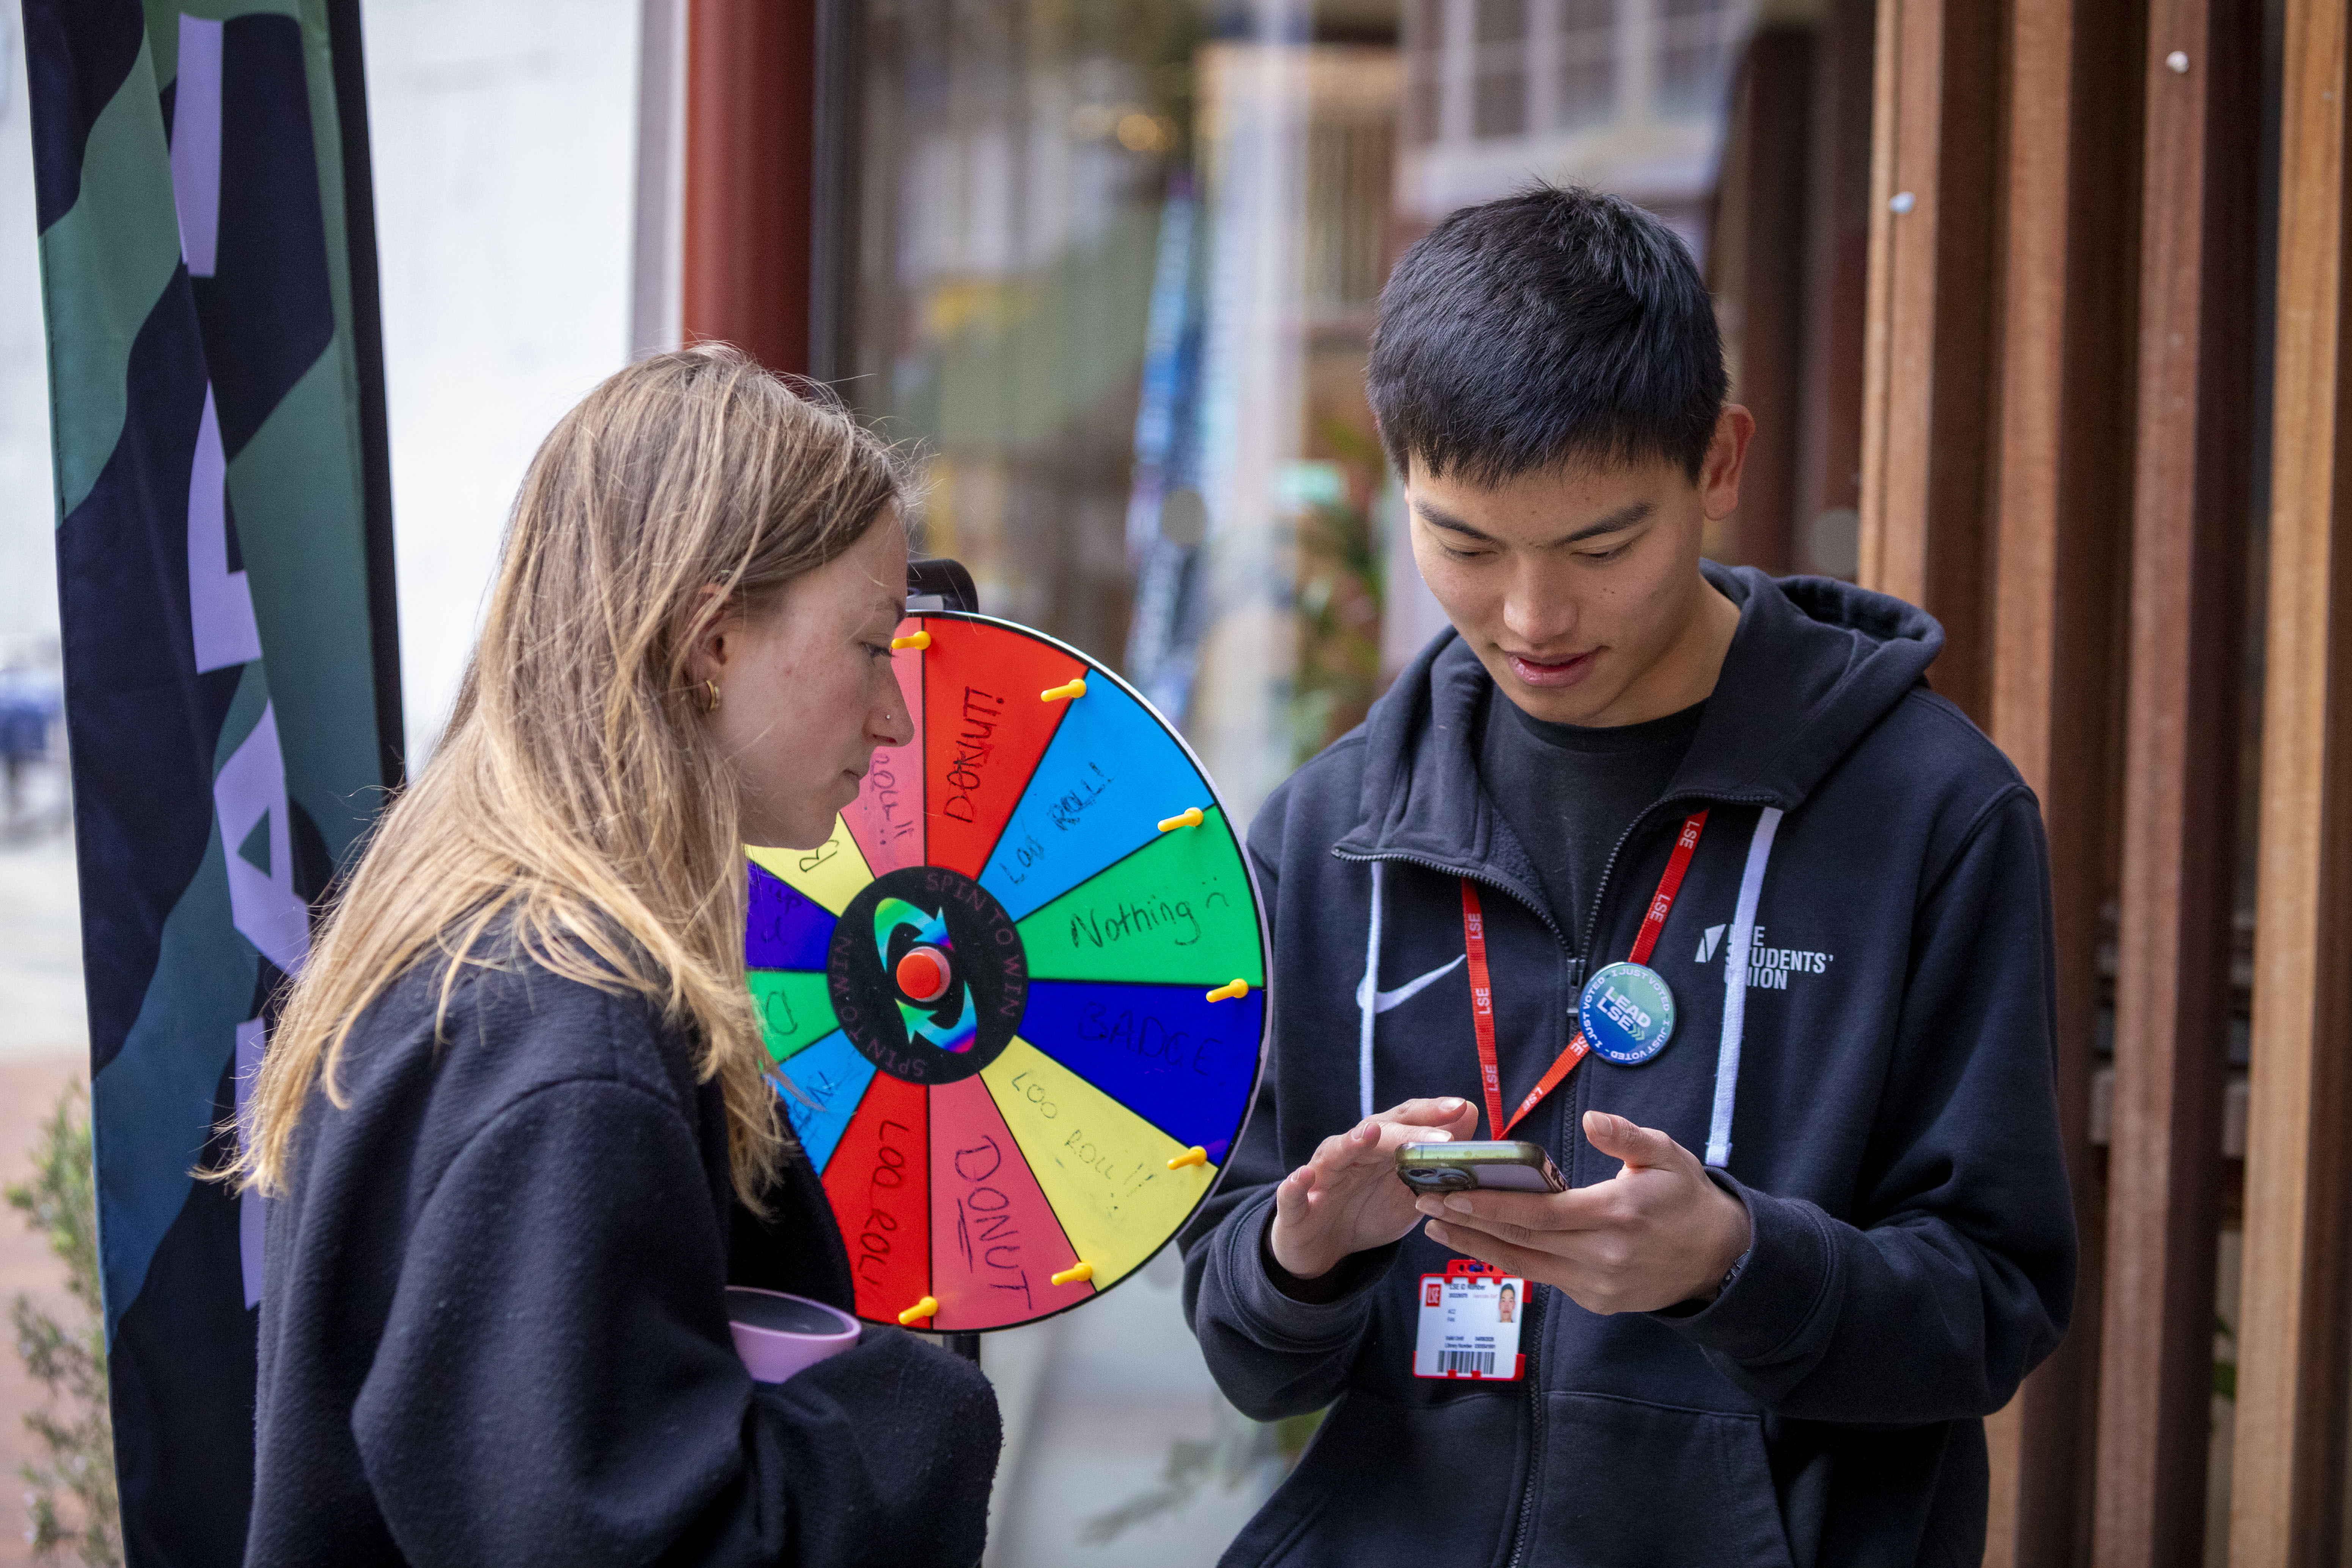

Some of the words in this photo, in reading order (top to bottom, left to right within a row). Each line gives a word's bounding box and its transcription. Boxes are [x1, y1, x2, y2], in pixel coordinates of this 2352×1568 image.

[1679, 820, 1700, 849] LSE
[926, 872, 988, 911] SPIN
[1650, 894, 1671, 923] LSE
[988, 908, 1014, 946] TO
[1070, 894, 1201, 948] Nothing
[1468, 913, 1482, 940] LSE
[833, 936, 853, 996] WIN
[1725, 944, 1834, 974] UDENTS'
[999, 955, 1023, 1017] WIN
[1476, 988, 1491, 1014] LSE
[1583, 976, 1606, 1010] VOTED
[1619, 968, 1648, 980] JUST
[1648, 977, 1670, 1012] VOTED
[841, 1005, 864, 1042] TO
[1596, 996, 1634, 1032] LSE
[1604, 986, 1651, 1028] LEAD
[1582, 1012, 1598, 1040] JUST
[1648, 1027, 1667, 1054] JUST
[867, 1038, 926, 1077] SPIN
[1570, 1035, 1589, 1056] SE
[1610, 1050, 1647, 1061] VOTED
[1011, 1069, 1058, 1119] LOO
[1485, 1064, 1499, 1091] LSE
[1522, 1087, 1543, 1112] LSE
[872, 1120, 909, 1189] LOO
[954, 1135, 1032, 1310] DONUT
